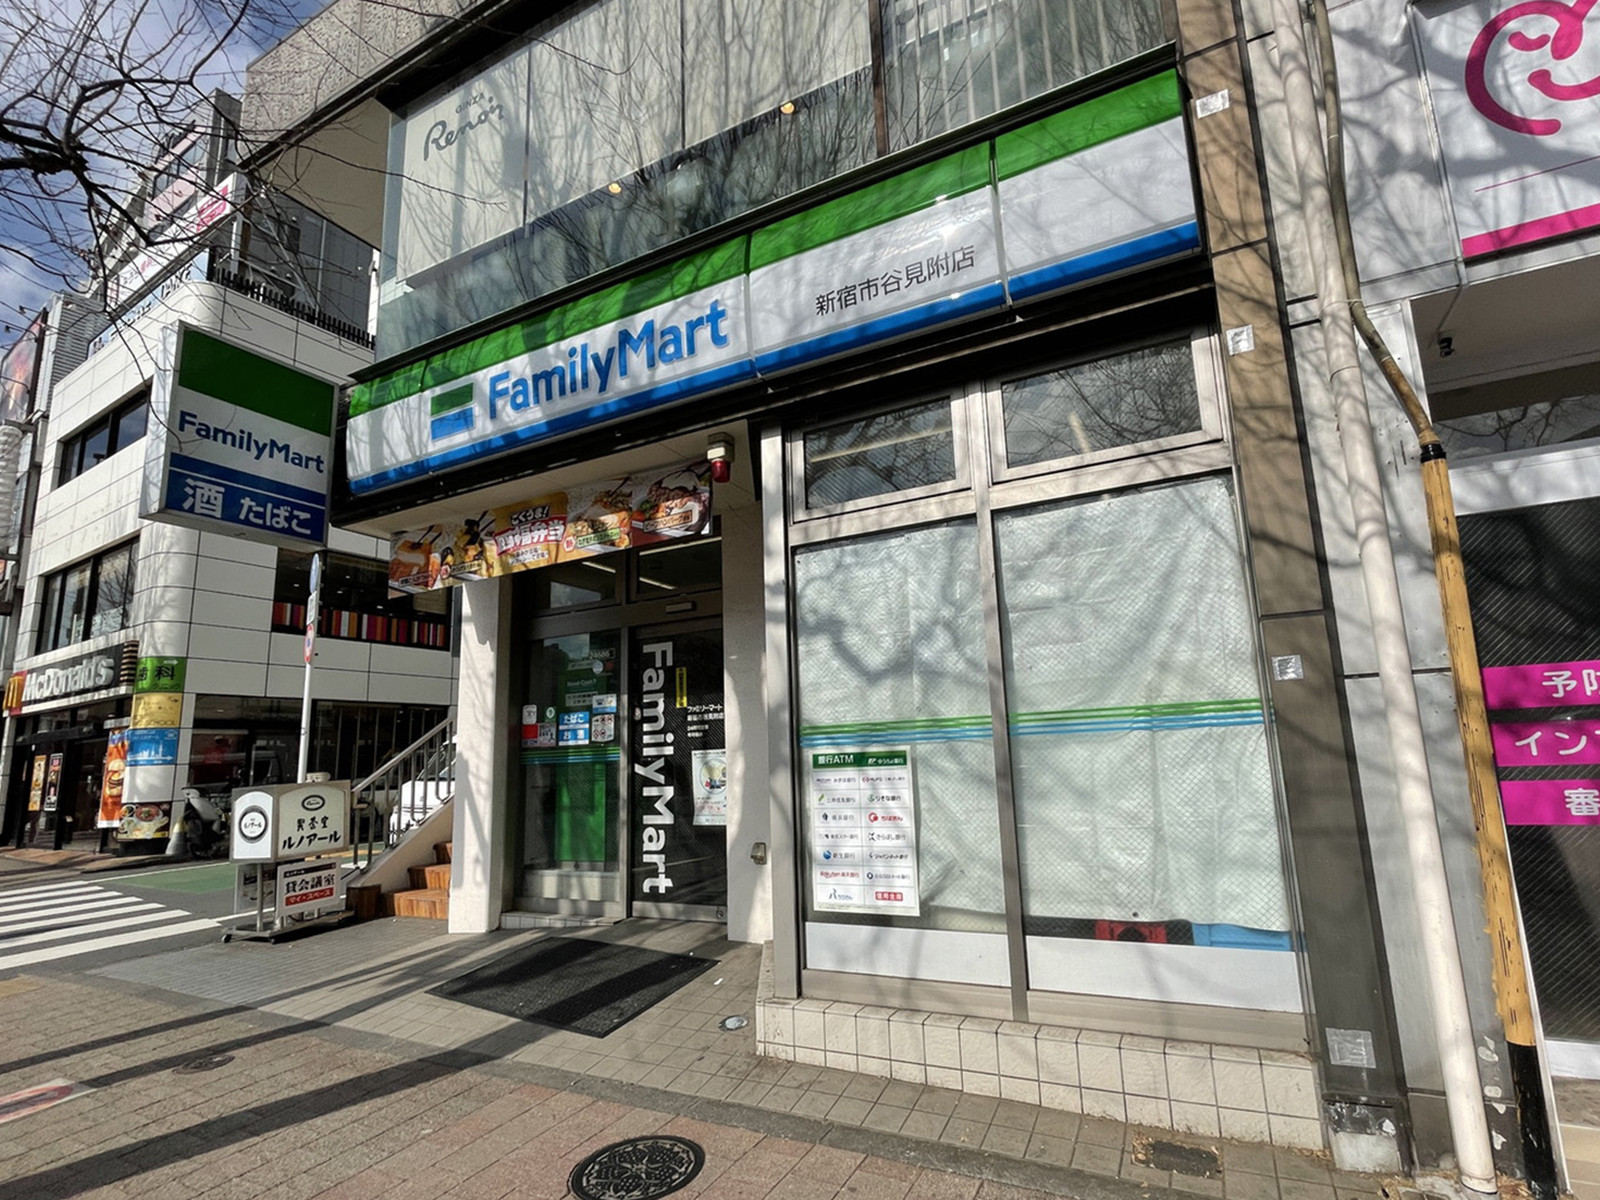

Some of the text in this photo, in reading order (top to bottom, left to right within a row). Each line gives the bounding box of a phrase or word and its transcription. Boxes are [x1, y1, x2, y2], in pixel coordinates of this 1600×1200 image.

[423, 96, 505, 162] Renoir
[455, 92, 485, 114] GINZA
[815, 245, 975, 316] 新宿市谷見附店
[488, 298, 730, 421] FamilyMart
[178, 409, 325, 474] FamilyMart
[182, 478, 312, 535] 酒 たばこ
[563, 714, 584, 724] たばこ
[1514, 730, 1600, 756] イン
[634, 641, 674, 894] FamilyMart
[282, 830, 342, 850] ルノアール
[285, 873, 335, 895] 貸会議室
